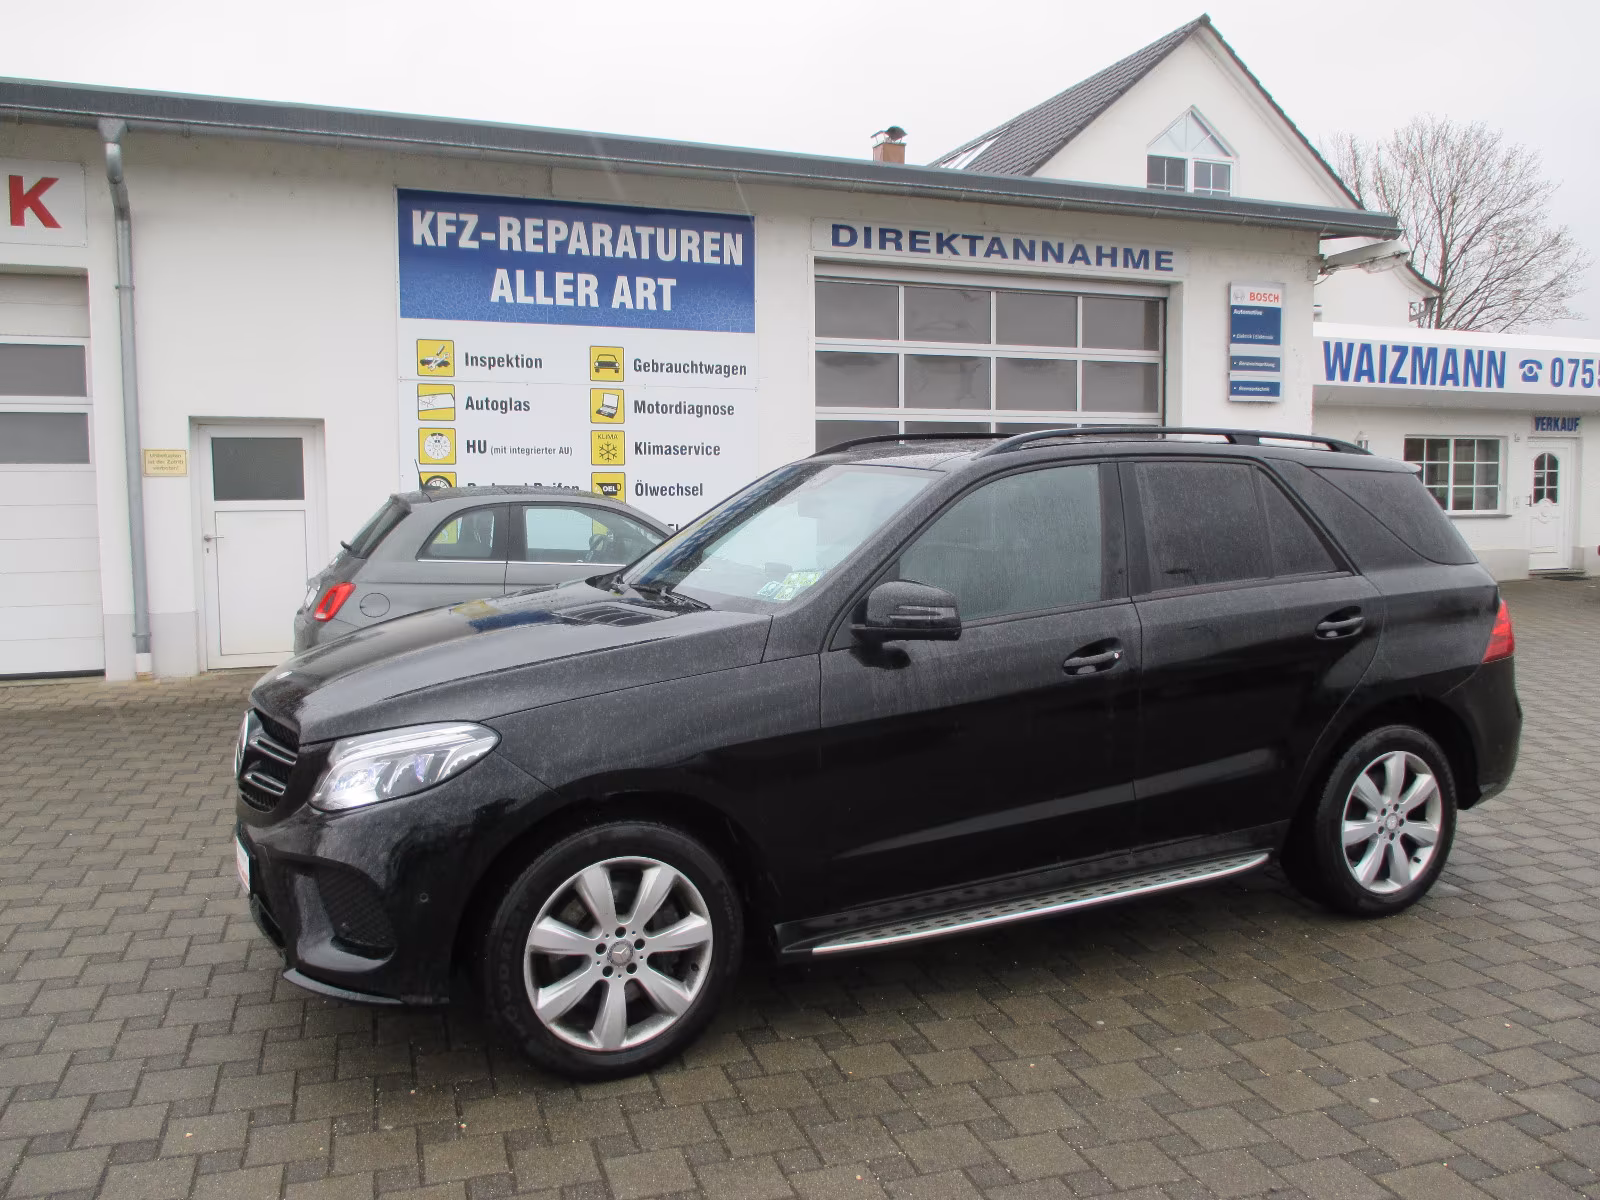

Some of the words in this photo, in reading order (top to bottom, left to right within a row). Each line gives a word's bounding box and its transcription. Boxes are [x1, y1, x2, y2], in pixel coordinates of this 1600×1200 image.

[9, 174, 62, 229] K
[412, 209, 743, 266] KFZ-REPARATUREN
[831, 223, 1174, 272] DIREKTANNAHME
[490, 268, 599, 308] ALLER
[611, 275, 677, 311] ART
[1249, 291, 1280, 303] BOSCH
[464, 352, 543, 371] Inspektion
[633, 357, 747, 378] Gebrauchtwagen
[1322, 340, 1506, 389] WAIZMANN
[1550, 356, 1600, 389] 075
[465, 395, 531, 414] Autoglas
[633, 399, 735, 418] Motordiagnose
[1534, 416, 1581, 432] VERKAUF
[466, 439, 487, 454] HU
[490, 446, 507, 455] (mit
[509, 446, 556, 456] integrierter
[558, 446, 573, 456] AU)
[634, 441, 721, 456] Klimaservice
[635, 479, 704, 497] Ölwechsel
